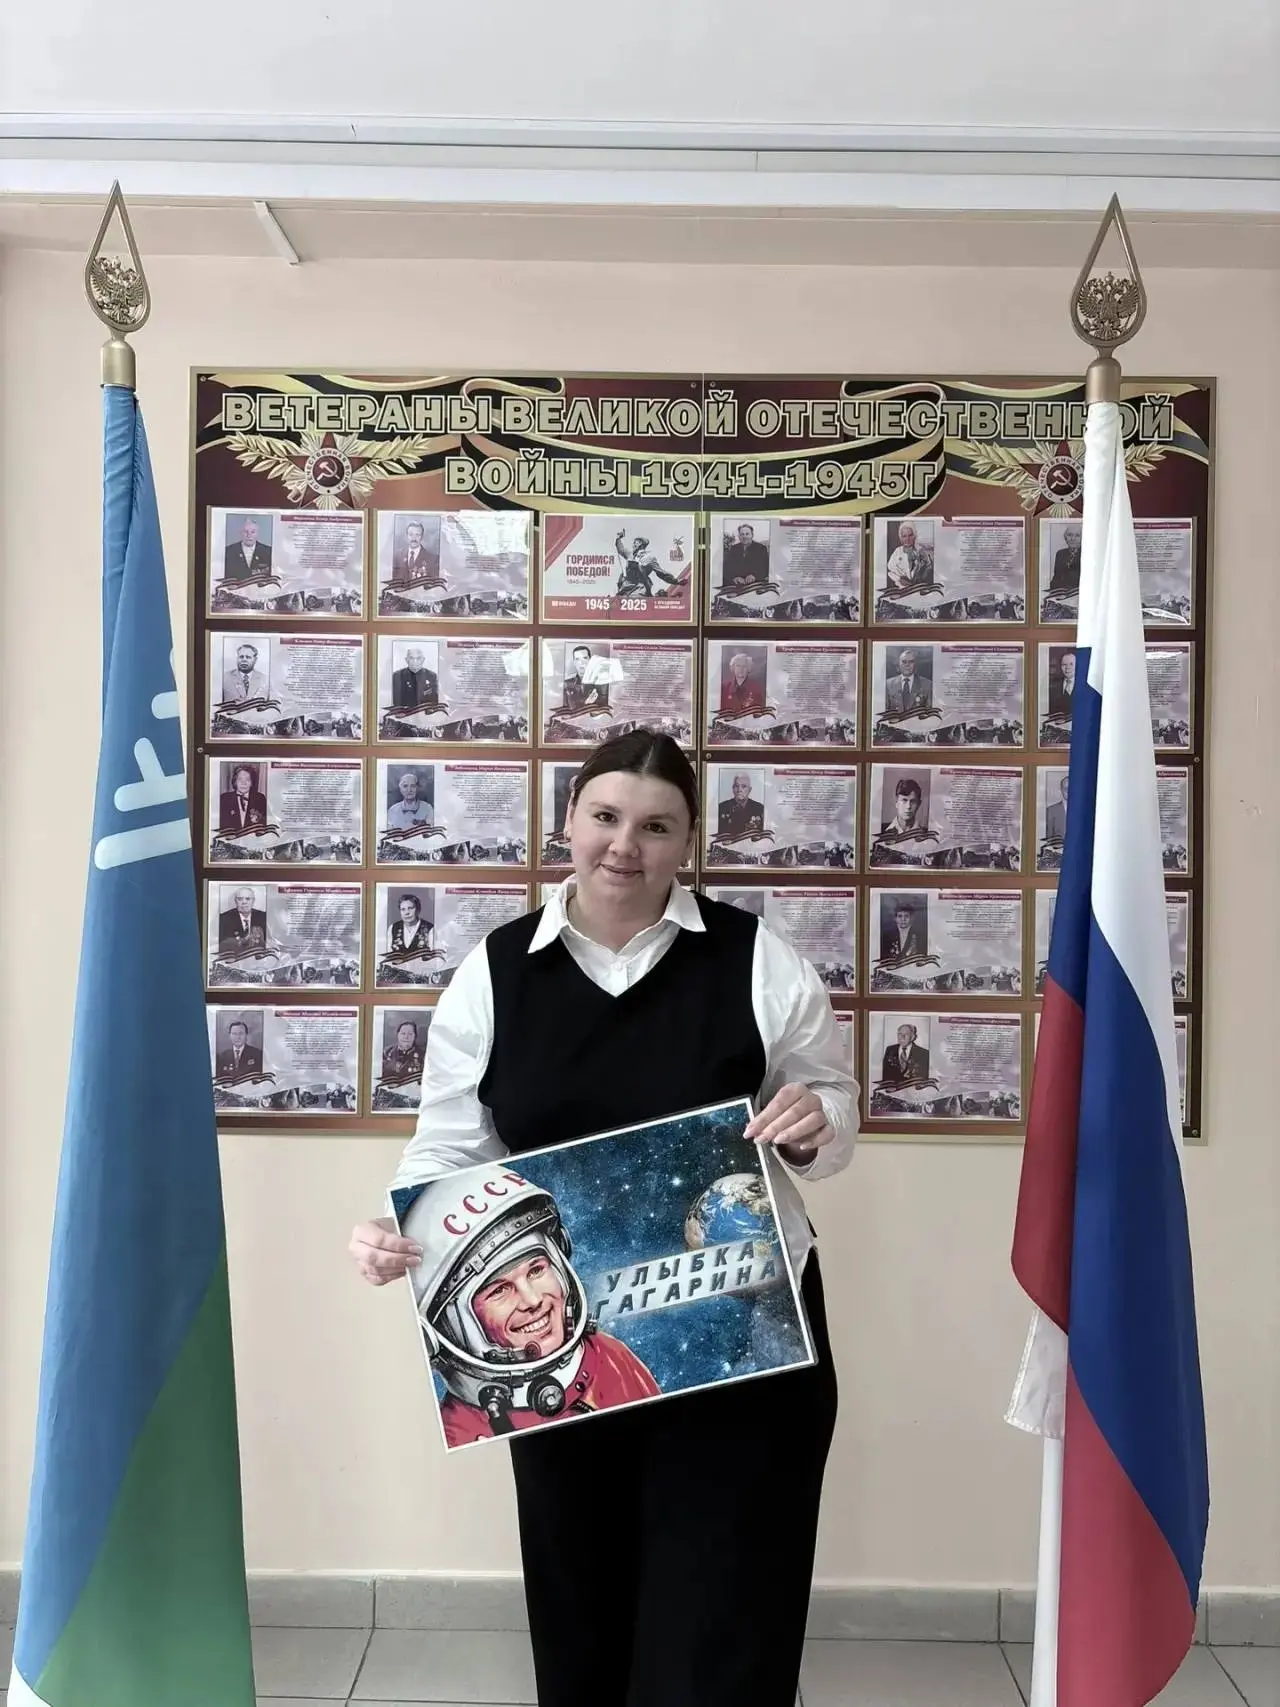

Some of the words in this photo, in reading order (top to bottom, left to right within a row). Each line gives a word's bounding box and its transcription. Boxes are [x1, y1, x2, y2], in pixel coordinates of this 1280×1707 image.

[221, 393, 491, 436] ВЕТЕРАНЫ
[502, 390, 738, 438] ВЕЛИКОЙ
[445, 448, 631, 497] ВОЙНЫ
[640, 460, 940, 501] 1941-1945Г
[566, 554, 615, 566] ГОРДИМСЯ
[566, 566, 611, 578] ПОБЕДОЙ!
[585, 598, 610, 610] 1945
[620, 598, 648, 611] 2025
[443, 1172, 527, 1236] СССР
[595, 1258, 777, 1320] ГАГАРИНА
[606, 1240, 755, 1293] УЛЫБКА
